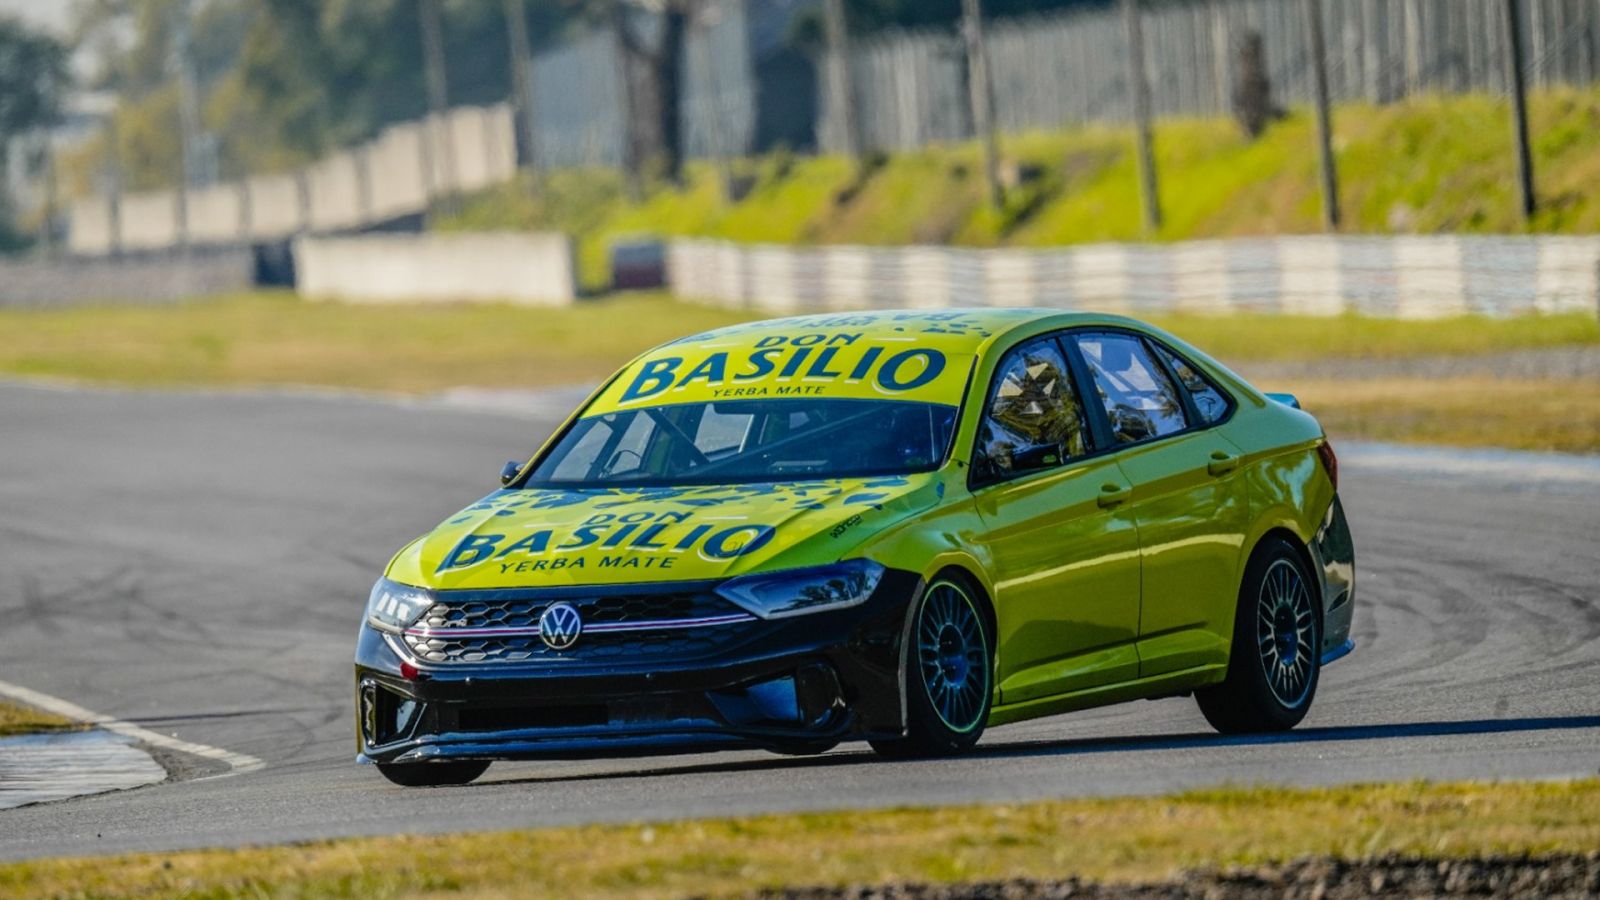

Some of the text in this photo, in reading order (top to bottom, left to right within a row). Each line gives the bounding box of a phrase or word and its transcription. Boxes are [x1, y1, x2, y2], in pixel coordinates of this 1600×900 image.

[753, 332, 863, 349] DON
[619, 346, 947, 402] BASILIO
[712, 384, 826, 398] YERBA MATE
[583, 510, 694, 527] DON
[435, 523, 778, 573] BASILIO
[500, 556, 678, 575] YERBA MATE
